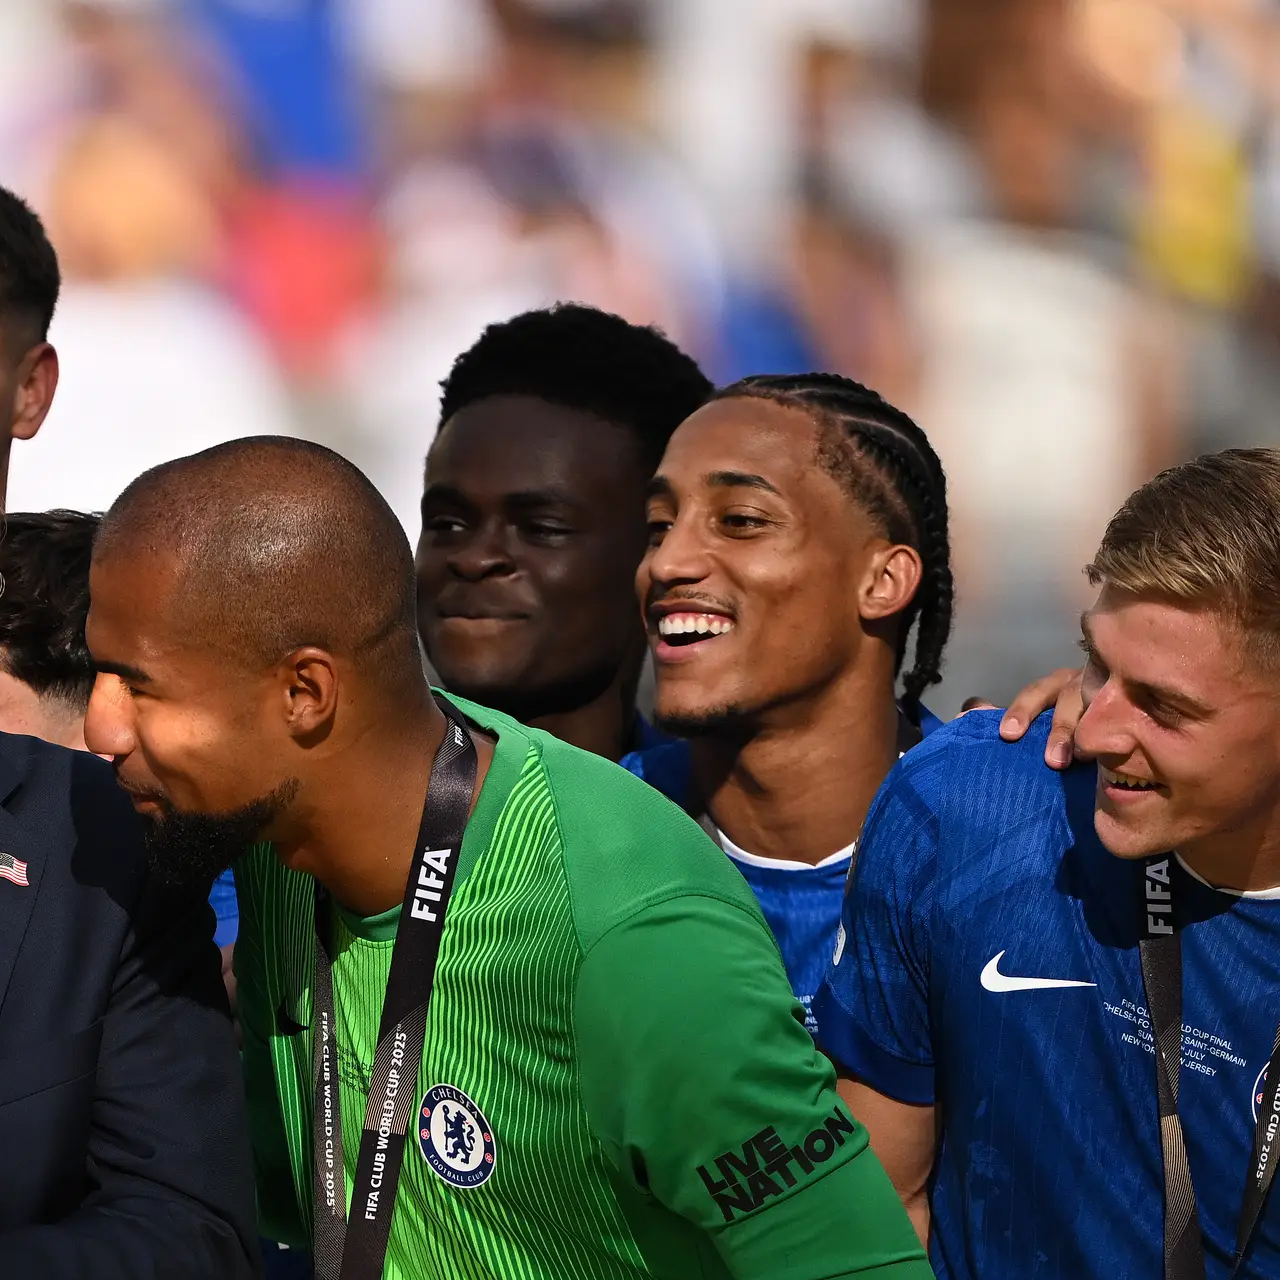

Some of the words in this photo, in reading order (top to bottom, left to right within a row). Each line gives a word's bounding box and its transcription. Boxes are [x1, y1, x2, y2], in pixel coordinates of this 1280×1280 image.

[410, 849, 452, 922] FIFA
[1145, 859, 1174, 935] FIFA
[1121, 998, 1136, 1012] FIFA
[1138, 1018, 1150, 1029] FC
[1192, 1028, 1210, 1039] CUP
[1209, 1033, 1233, 1051] FINAL
[322, 1045, 331, 1081] CLUB
[1121, 1032, 1140, 1047] NEW
[1185, 1061, 1217, 1078] JERSEY
[1184, 1035, 1247, 1068] SAINT-GERMAIN
[1185, 1049, 1206, 1061] JULY
[386, 1069, 401, 1098] CUP
[323, 1085, 333, 1137] WORLD
[431, 1087, 478, 1119] CHELSEA
[377, 1098, 396, 1150] WORLD
[1266, 1113, 1279, 1142] CUP
[325, 1140, 334, 1168] CUP
[429, 1153, 465, 1183] FOOTBALL
[467, 1170, 485, 1183] CLUB
[696, 1125, 783, 1197] LIVE
[710, 1105, 856, 1223] NATION
[371, 1153, 386, 1189] CLUB
[365, 1190, 381, 1221] FIFA
